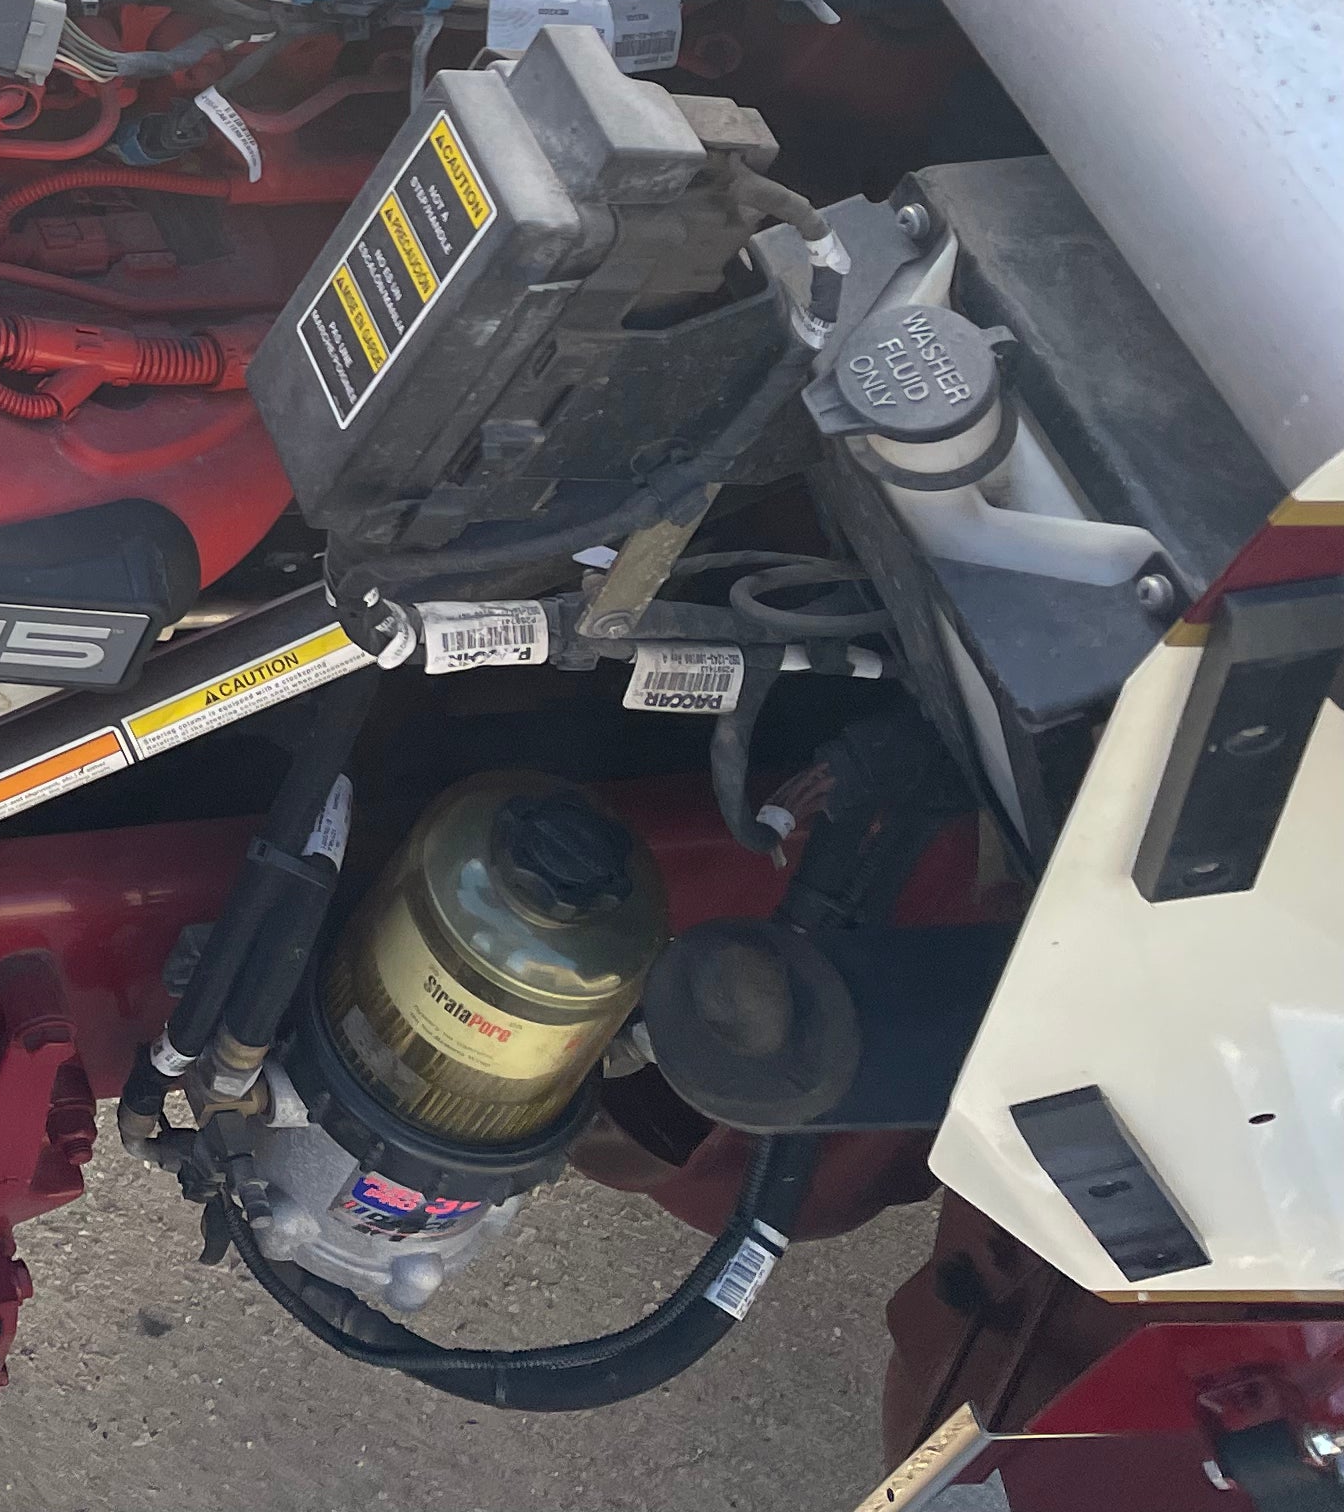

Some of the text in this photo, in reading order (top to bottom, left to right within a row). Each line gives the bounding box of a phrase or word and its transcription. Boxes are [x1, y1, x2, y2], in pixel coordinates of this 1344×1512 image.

[428, 184, 445, 210] NOT
[441, 144, 482, 220] CAUTION
[342, 286, 359, 312] MISE
[353, 312, 366, 330] EN
[329, 321, 353, 368] PAS UNE
[877, 338, 930, 401] FLUID
[903, 311, 971, 405] WASHER
[850, 355, 897, 407] ONLY
[217, 652, 299, 697] CAUTION
[644, 692, 723, 709] PACCAR
[143, 726, 176, 744] Steering
[177, 713, 206, 729] column
[217, 693, 254, 713] equipped
[255, 684, 272, 695] with
[424, 974, 512, 1043] StrataPore
